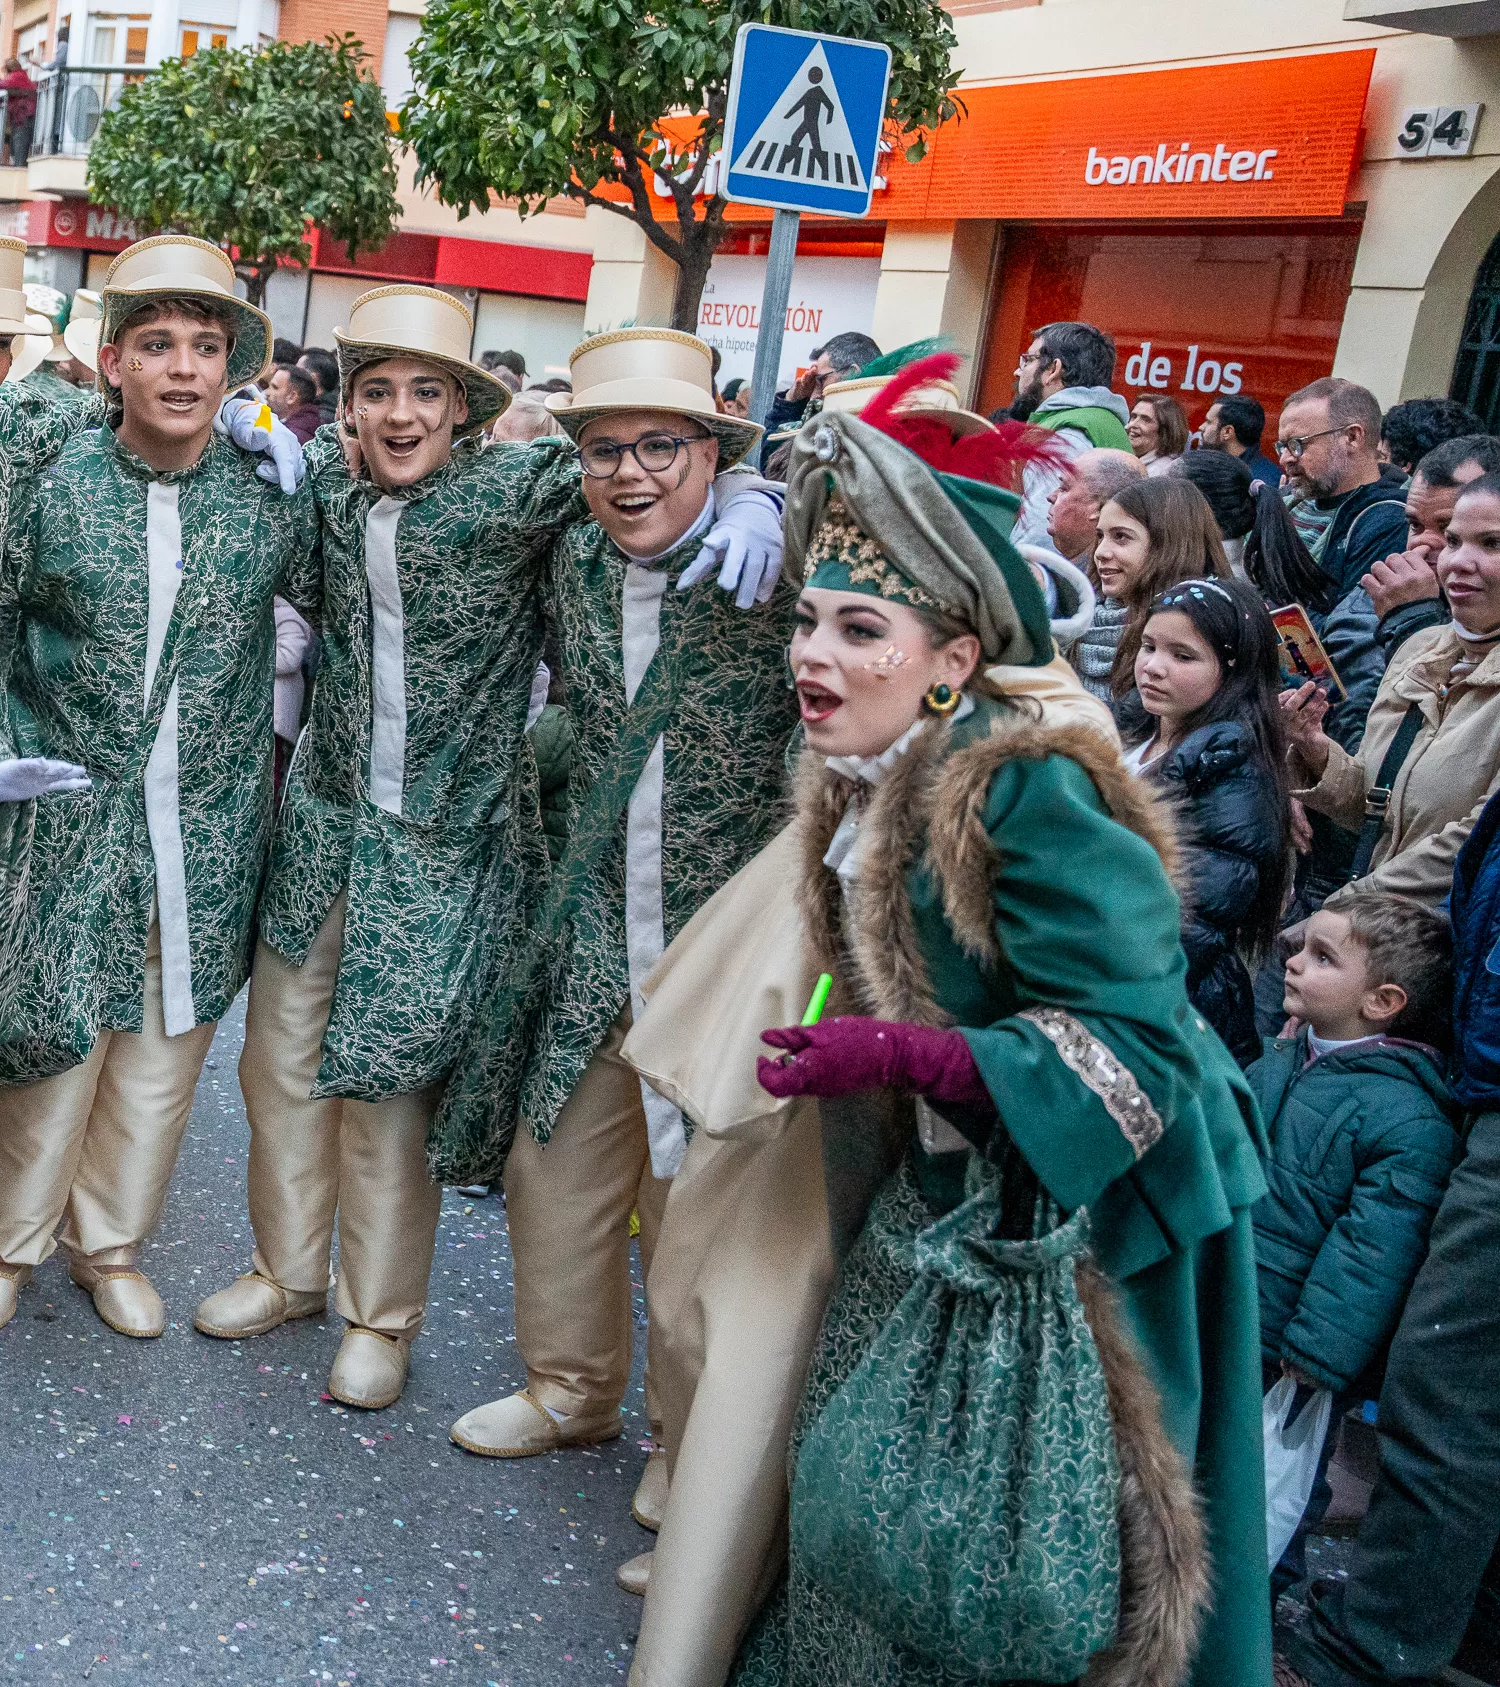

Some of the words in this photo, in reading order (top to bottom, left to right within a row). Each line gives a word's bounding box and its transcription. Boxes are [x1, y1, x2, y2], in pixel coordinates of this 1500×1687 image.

[1398, 110, 1464, 149] 54
[700, 301, 823, 332] REVOLIÓN
[725, 335, 755, 355] hipote
[1124, 341, 1171, 388] de
[1180, 344, 1243, 395] los
